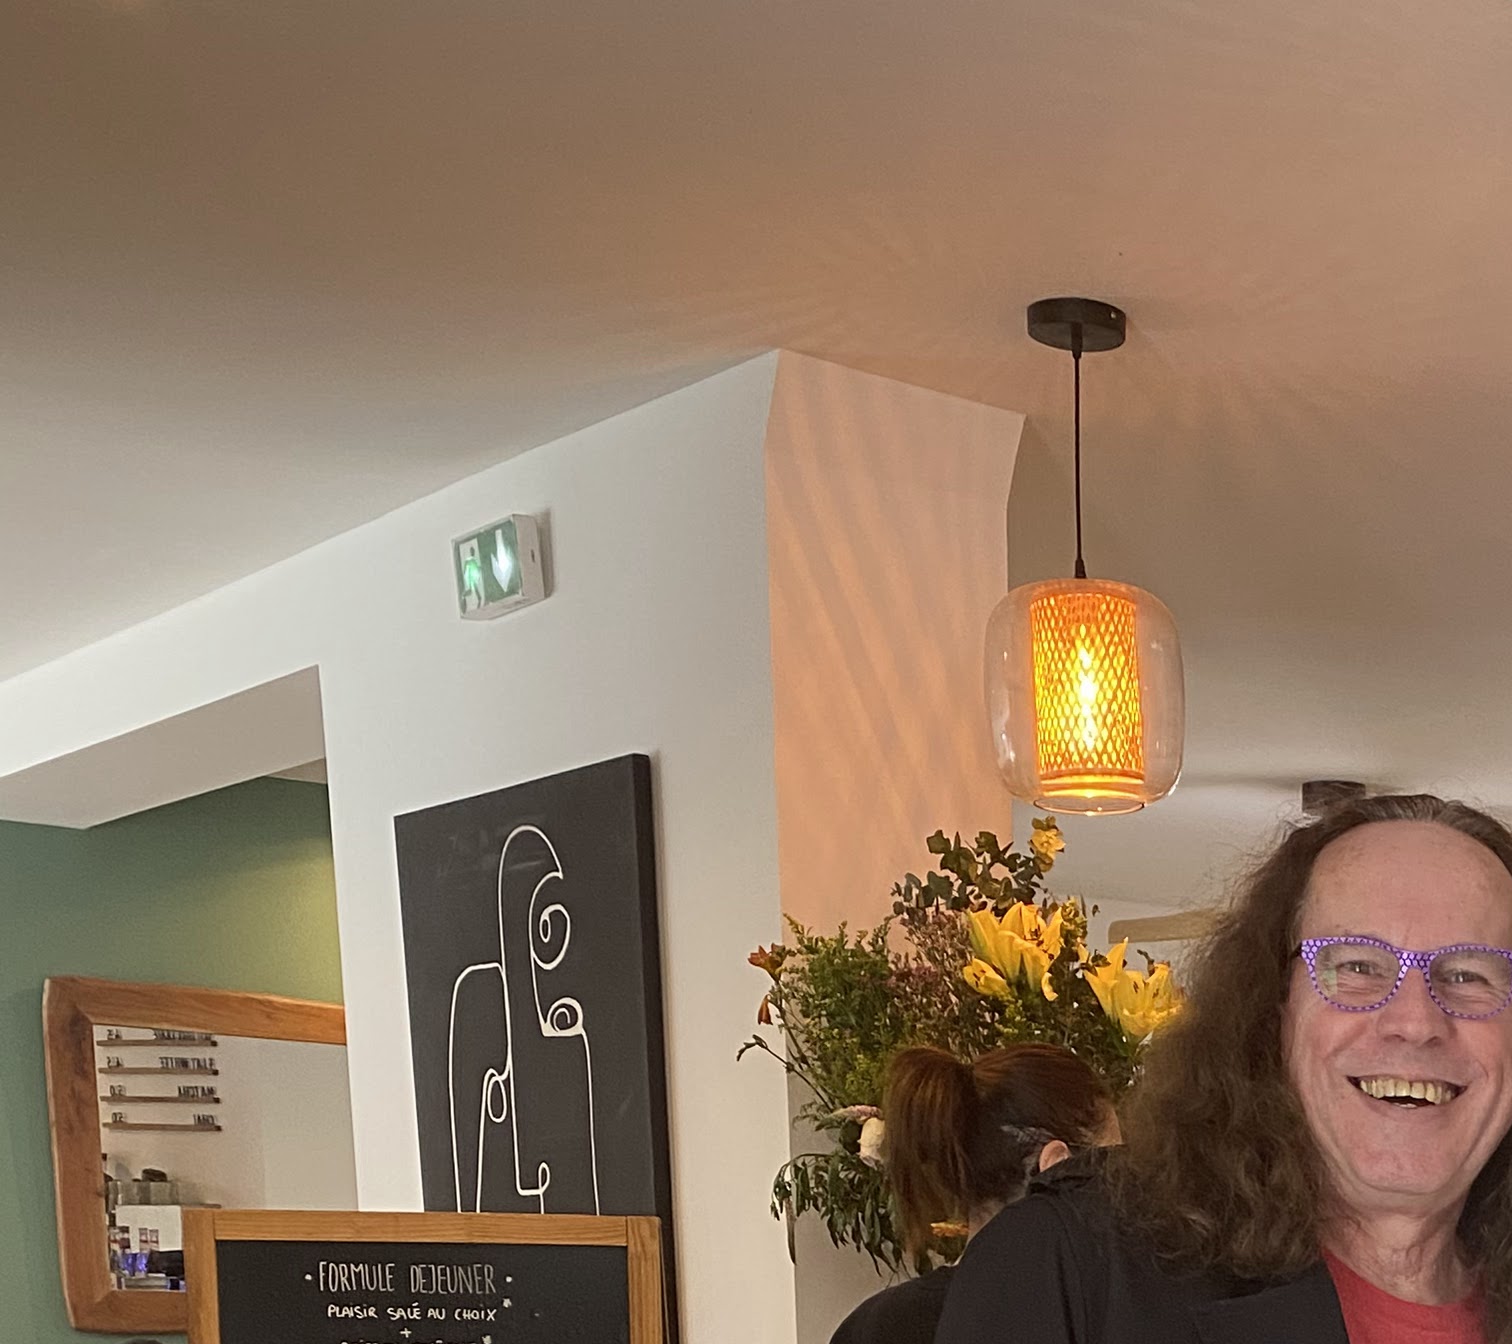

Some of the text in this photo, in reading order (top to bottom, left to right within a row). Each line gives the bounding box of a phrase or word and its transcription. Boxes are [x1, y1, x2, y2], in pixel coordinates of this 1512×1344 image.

[319, 1261, 496, 1294] FORMULE DEJEUNER
[387, 1302, 421, 1320] SALÉ
[428, 1308, 446, 1320] AU
[454, 1305, 497, 1321] CHOIX
